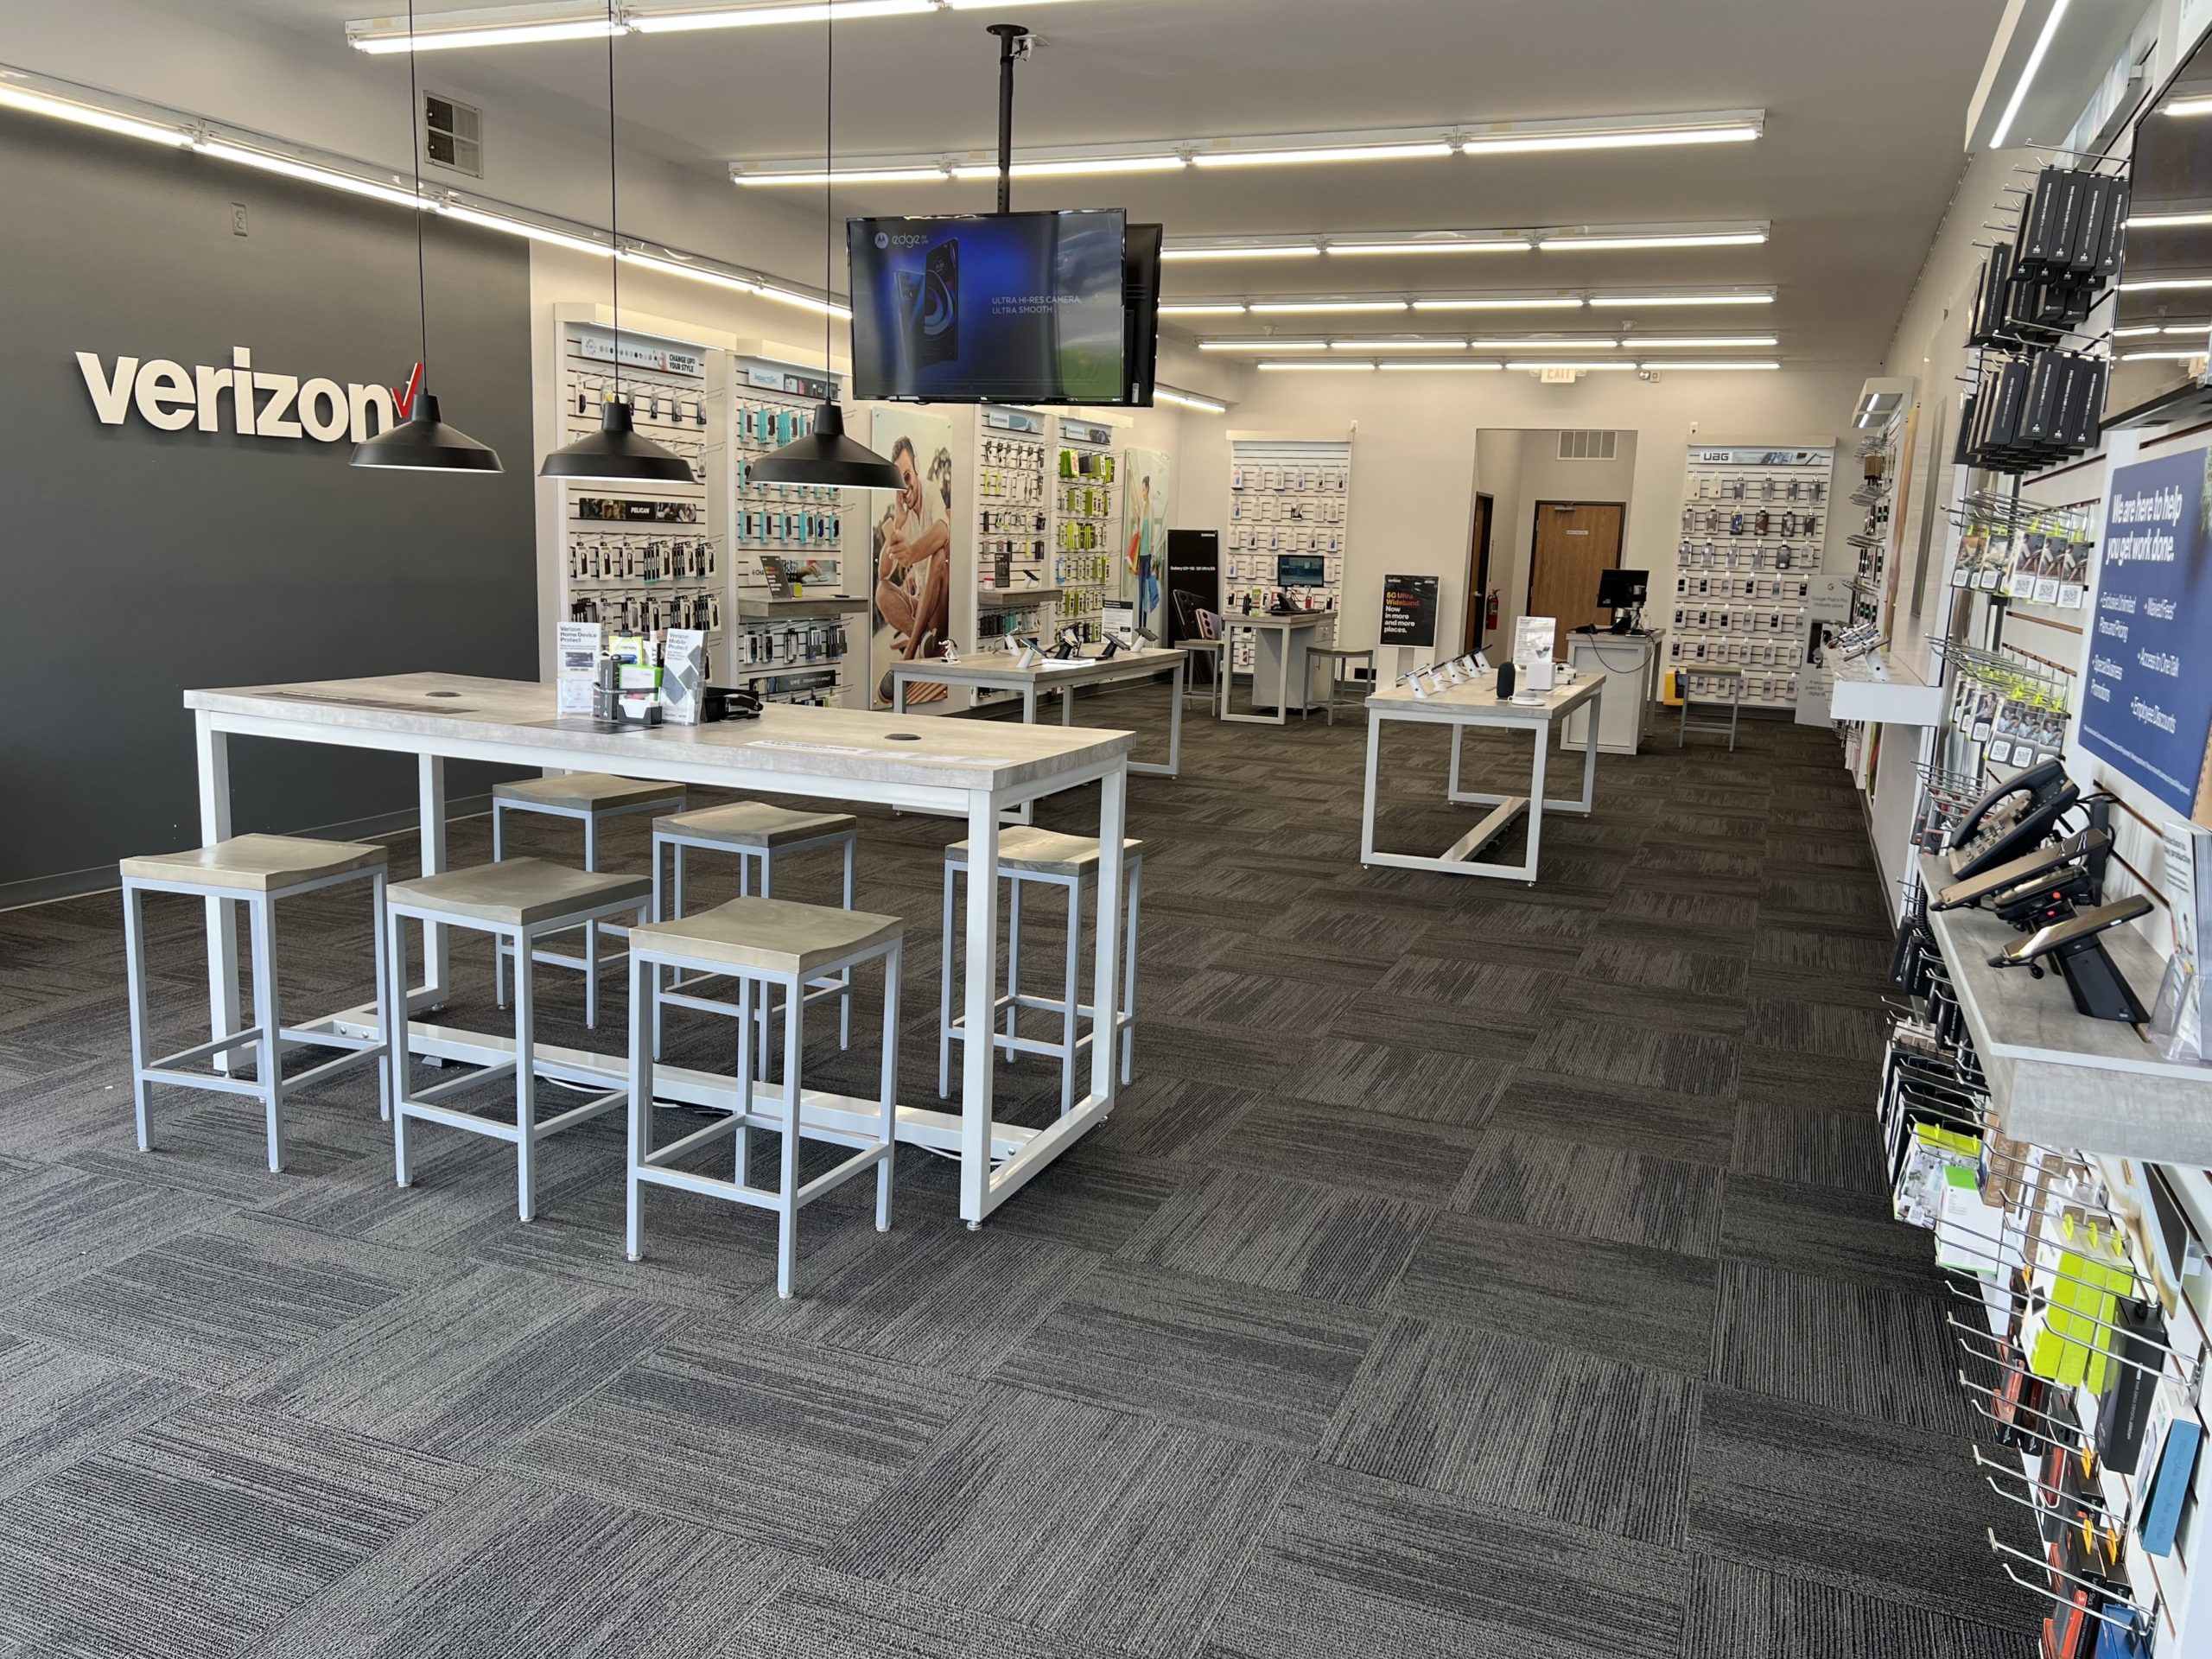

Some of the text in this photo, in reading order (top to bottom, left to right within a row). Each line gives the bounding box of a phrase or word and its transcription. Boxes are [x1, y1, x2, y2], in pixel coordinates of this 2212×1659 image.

[892, 232, 919, 248] edge
[670, 354, 686, 364] CHANGE
[682, 364, 694, 372] STYLE
[75, 346, 394, 443] verizon
[2112, 485, 2182, 527] We are here to help
[2106, 528, 2175, 566] you get work done.
